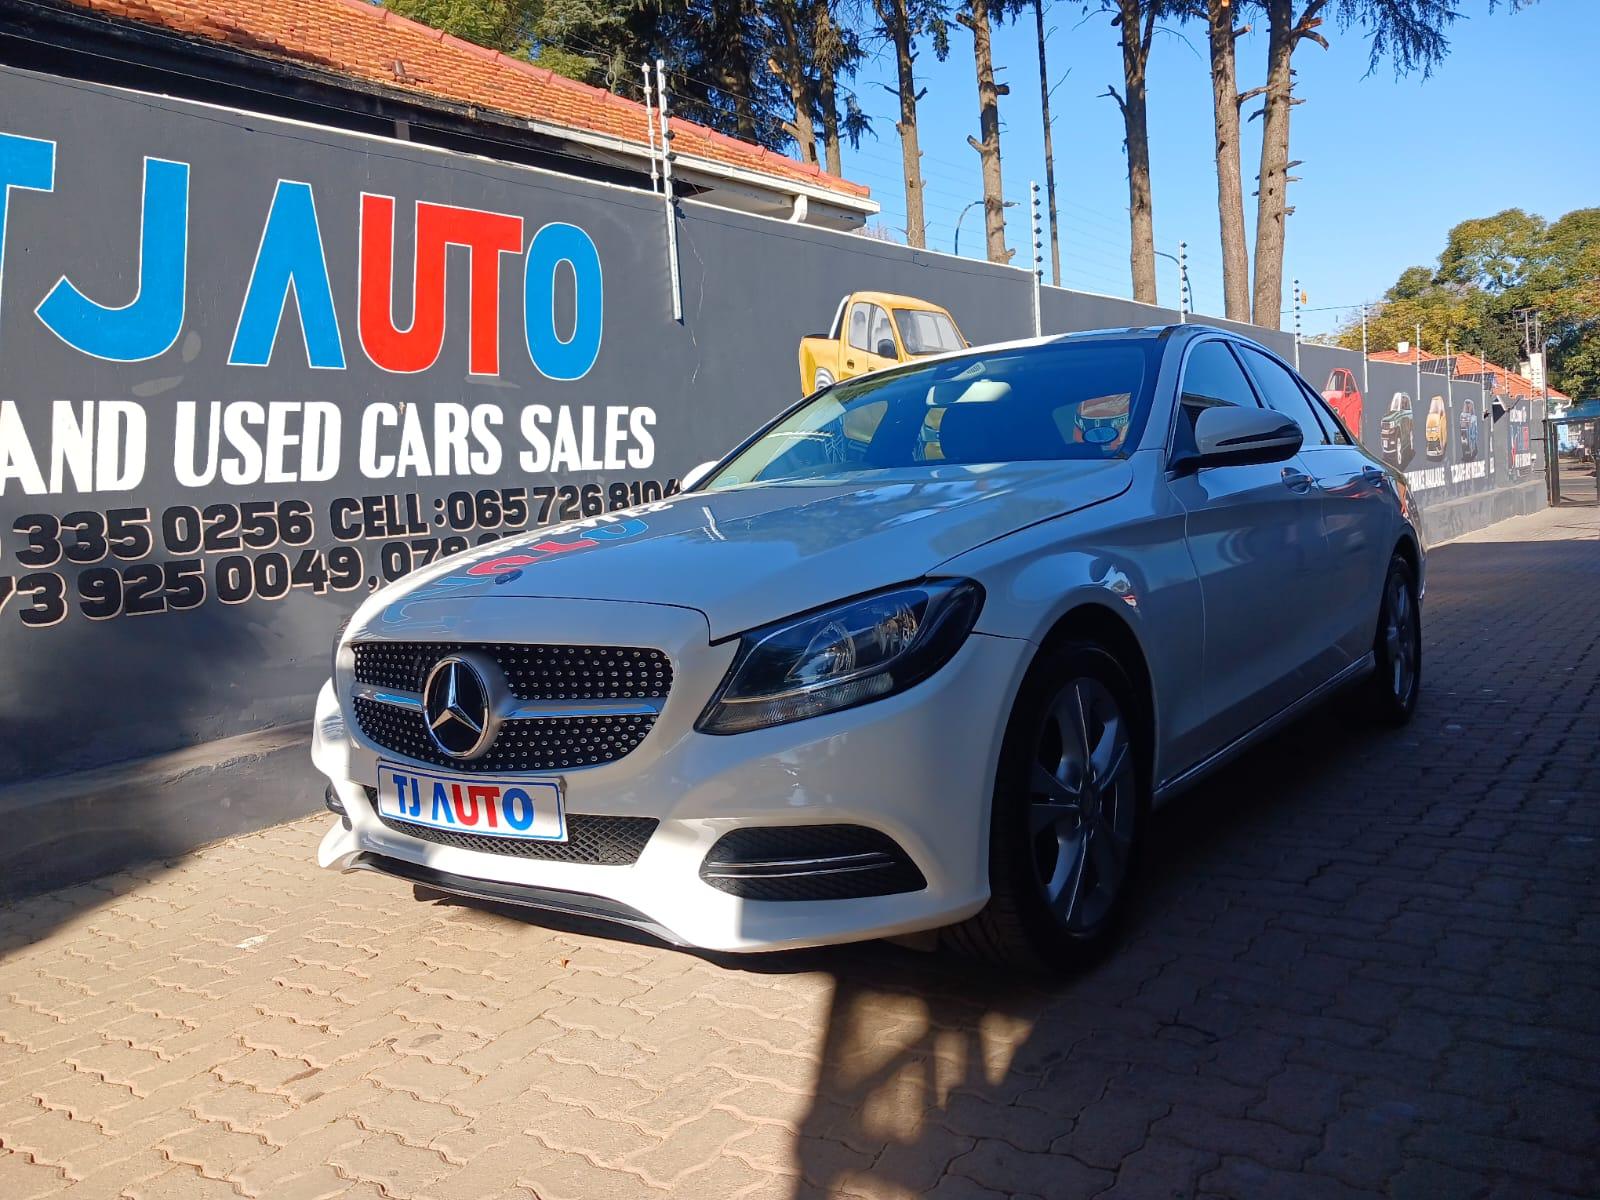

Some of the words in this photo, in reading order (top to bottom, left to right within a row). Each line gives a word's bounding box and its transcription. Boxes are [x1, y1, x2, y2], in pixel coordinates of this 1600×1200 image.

[227, 179, 603, 381] AUTO
[0, 400, 147, 496] AND
[173, 401, 342, 488] USED
[359, 402, 504, 479] CARS
[519, 403, 657, 473] SALES
[12, 507, 153, 569] 335
[162, 500, 315, 556] 0256
[533, 483, 605, 526] 726
[77, 558, 207, 621] 925
[392, 773, 421, 818] TJ
[432, 781, 535, 831] AUTO
